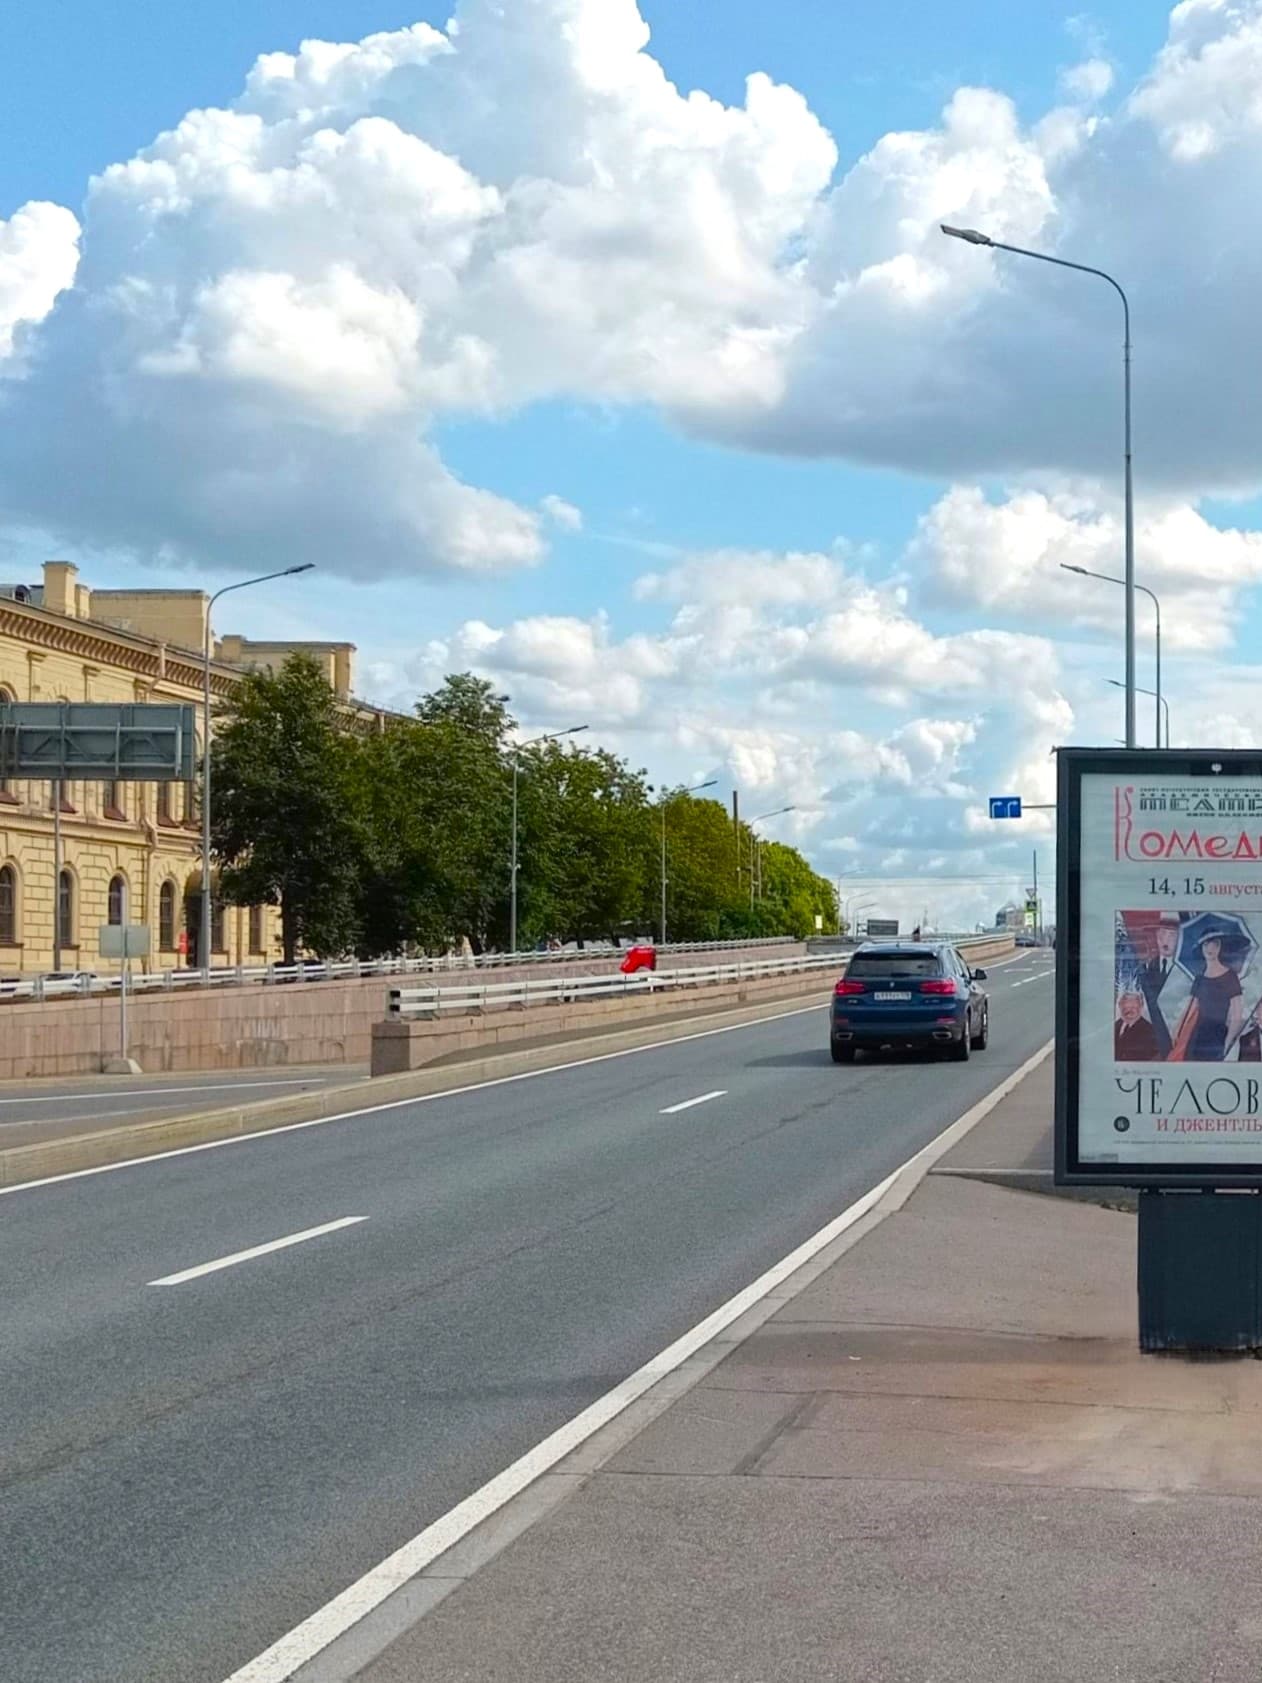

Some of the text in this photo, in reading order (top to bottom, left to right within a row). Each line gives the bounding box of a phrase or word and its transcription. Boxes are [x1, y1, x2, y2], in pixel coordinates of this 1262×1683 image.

[1148, 878, 1177, 897] 14,
[1183, 878, 1205, 895] 15
[1156, 1119, 1169, 1132] И
